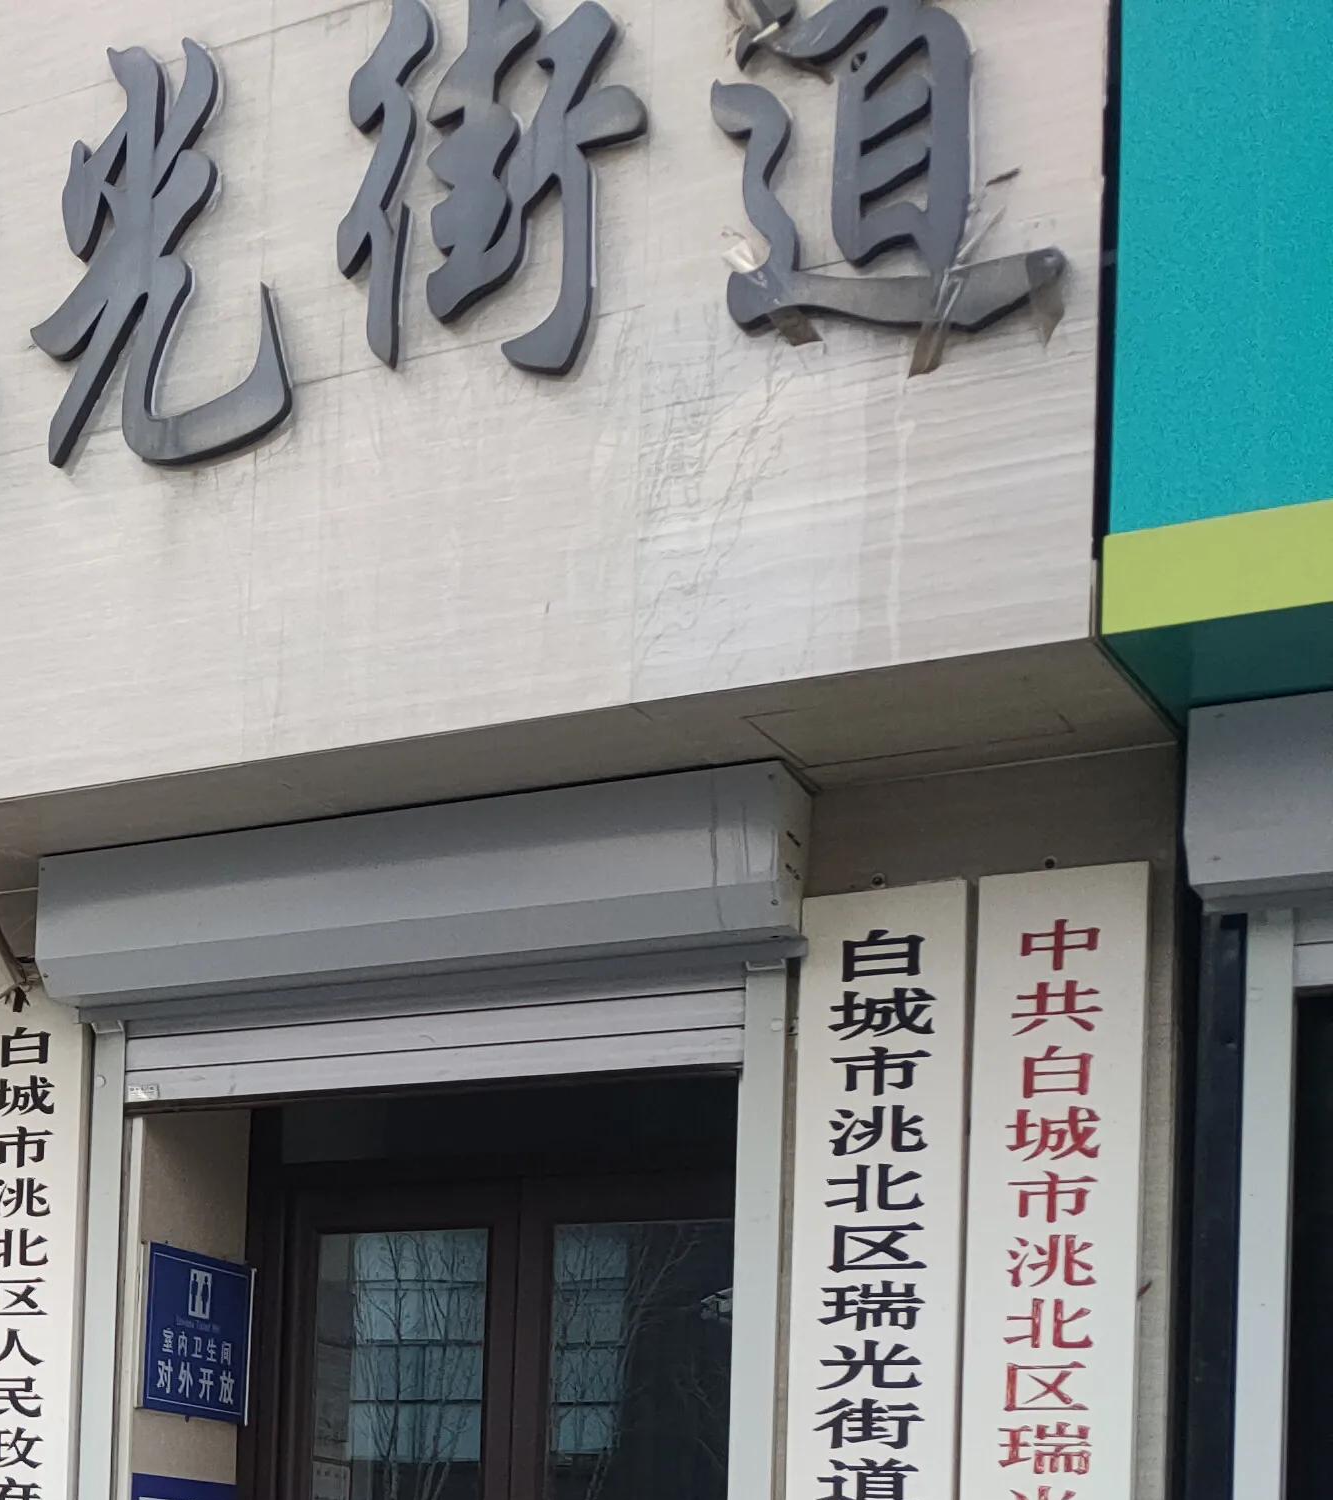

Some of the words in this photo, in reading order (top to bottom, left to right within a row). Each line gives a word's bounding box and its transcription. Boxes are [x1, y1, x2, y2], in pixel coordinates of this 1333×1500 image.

[161, 1327, 232, 1366] 室内卫生间
[156, 1358, 235, 1405] 对外开放
